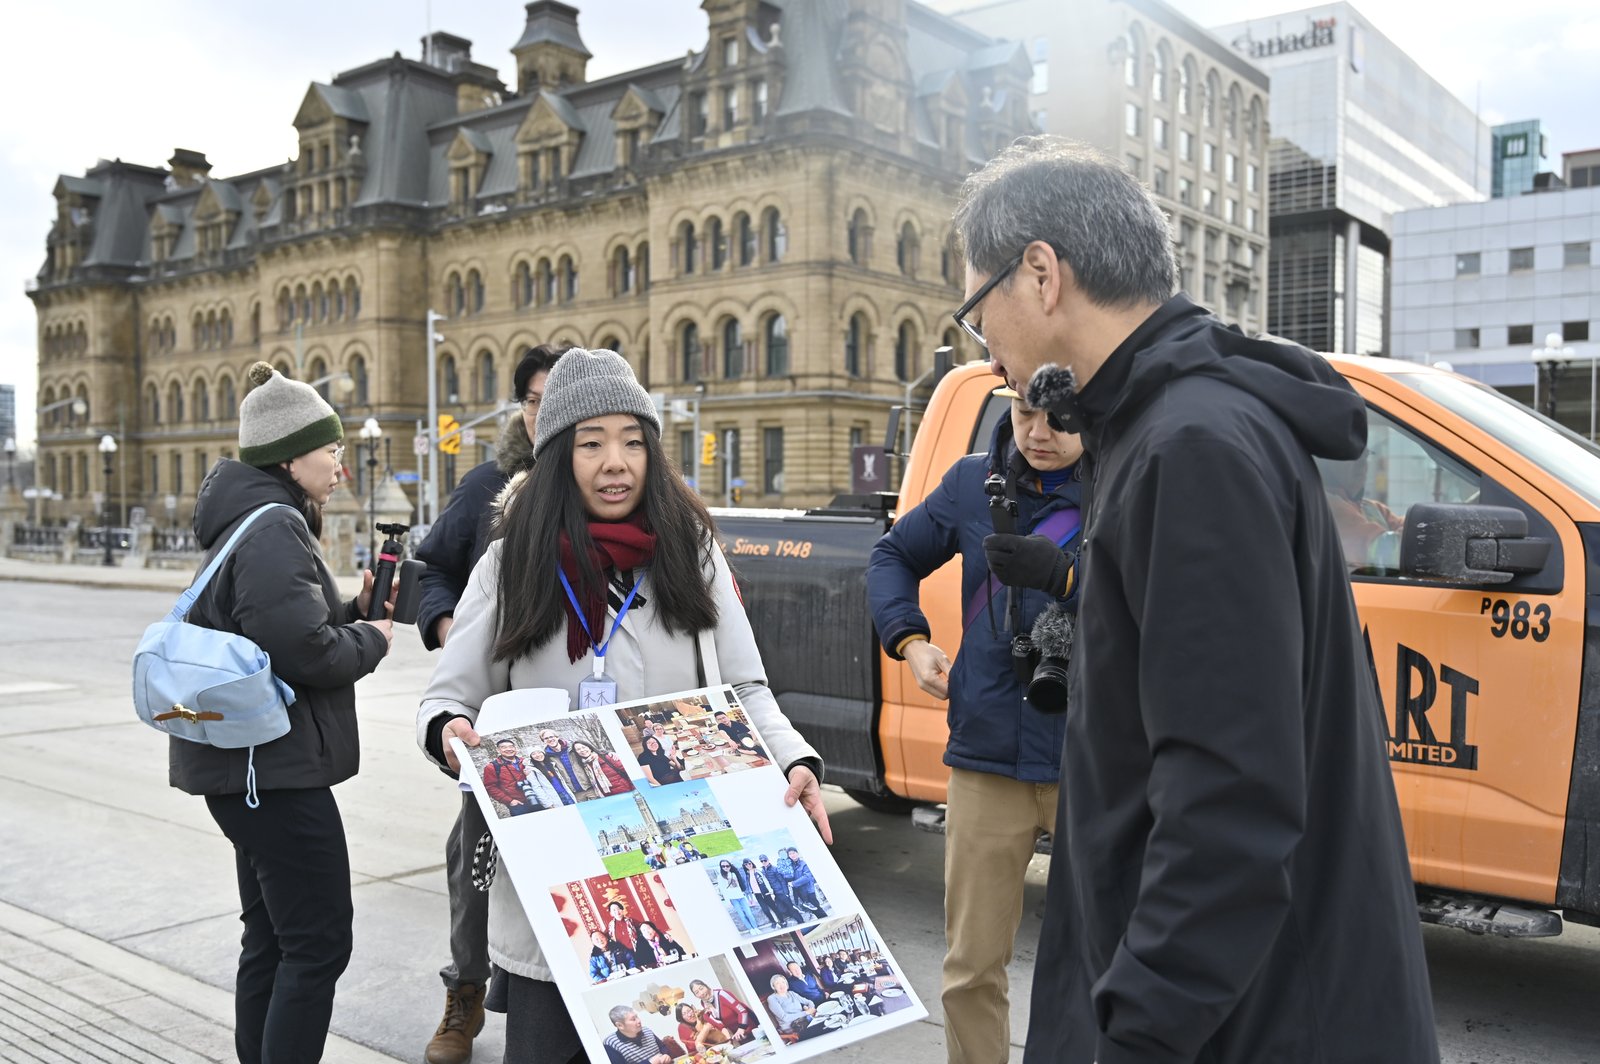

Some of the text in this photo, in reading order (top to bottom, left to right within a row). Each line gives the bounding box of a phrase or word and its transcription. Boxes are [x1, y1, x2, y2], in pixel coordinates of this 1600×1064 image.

[1231, 20, 1335, 58] Canada
[732, 538, 770, 556] Since
[775, 540, 812, 558] 1948
[1385, 741, 1457, 763] MITED
